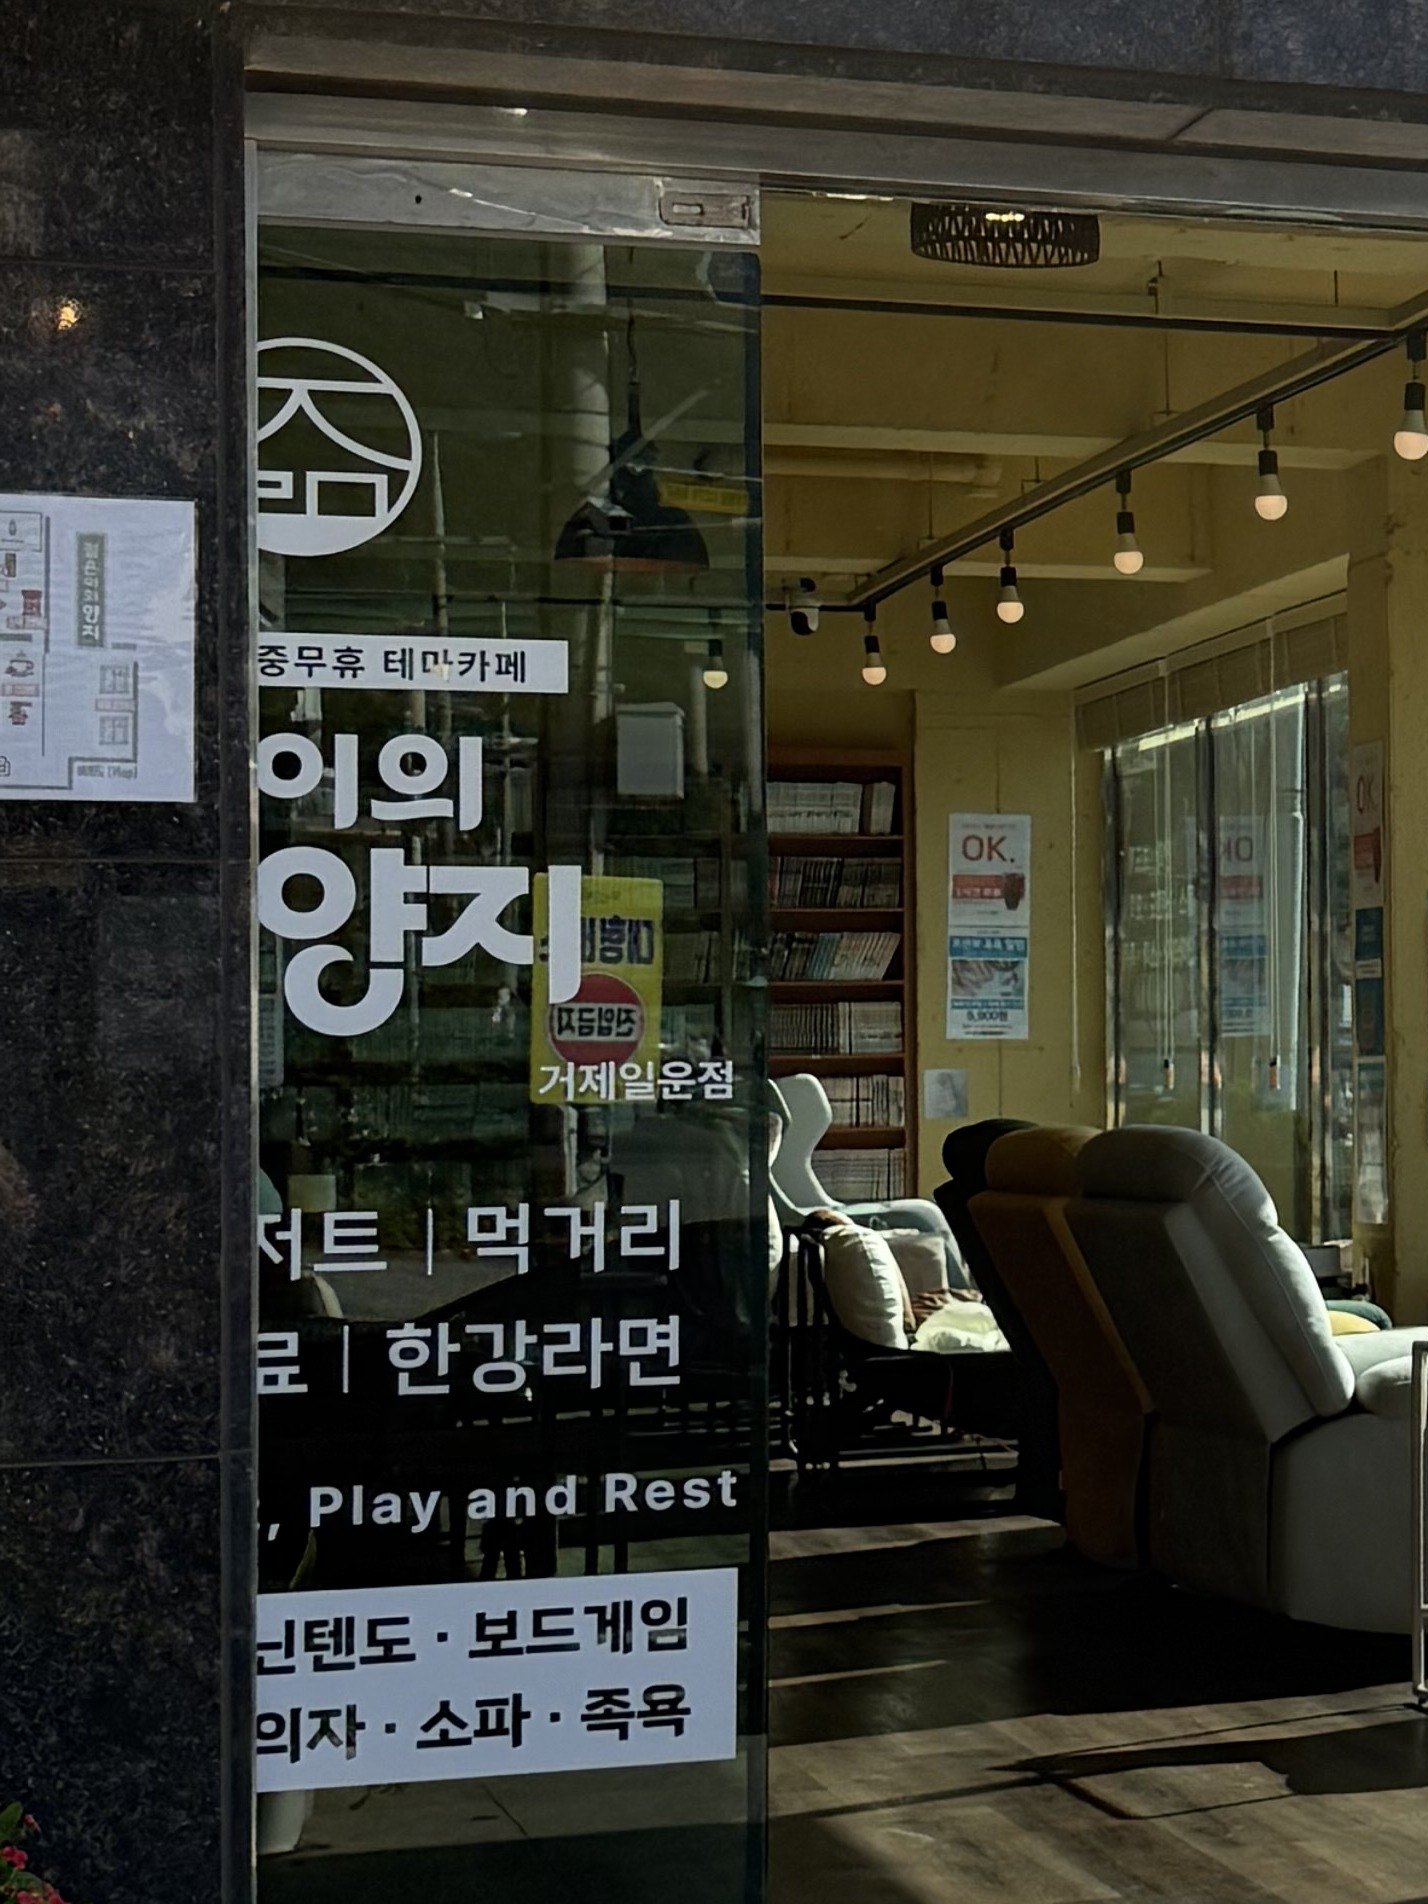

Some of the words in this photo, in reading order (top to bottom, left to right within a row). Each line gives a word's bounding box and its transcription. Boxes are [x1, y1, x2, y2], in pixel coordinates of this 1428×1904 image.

[383, 646, 528, 685] 테마카페
[961, 834, 1015, 863] OK.
[257, 845, 583, 1038] 양지
[538, 1060, 733, 1102] 거제일운점
[465, 1199, 682, 1276] 먹거리
[384, 1312, 683, 1396] 한강라면
[308, 1484, 442, 1535] Play
[466, 1474, 578, 1521] and
[604, 1469, 738, 1514] Rest
[255, 1611, 418, 1676] 닌텐도
[467, 1595, 690, 1661] 보드게임
[255, 1701, 367, 1764] 의자
[414, 1691, 533, 1751] 소파
[578, 1682, 693, 1742] 족욕
